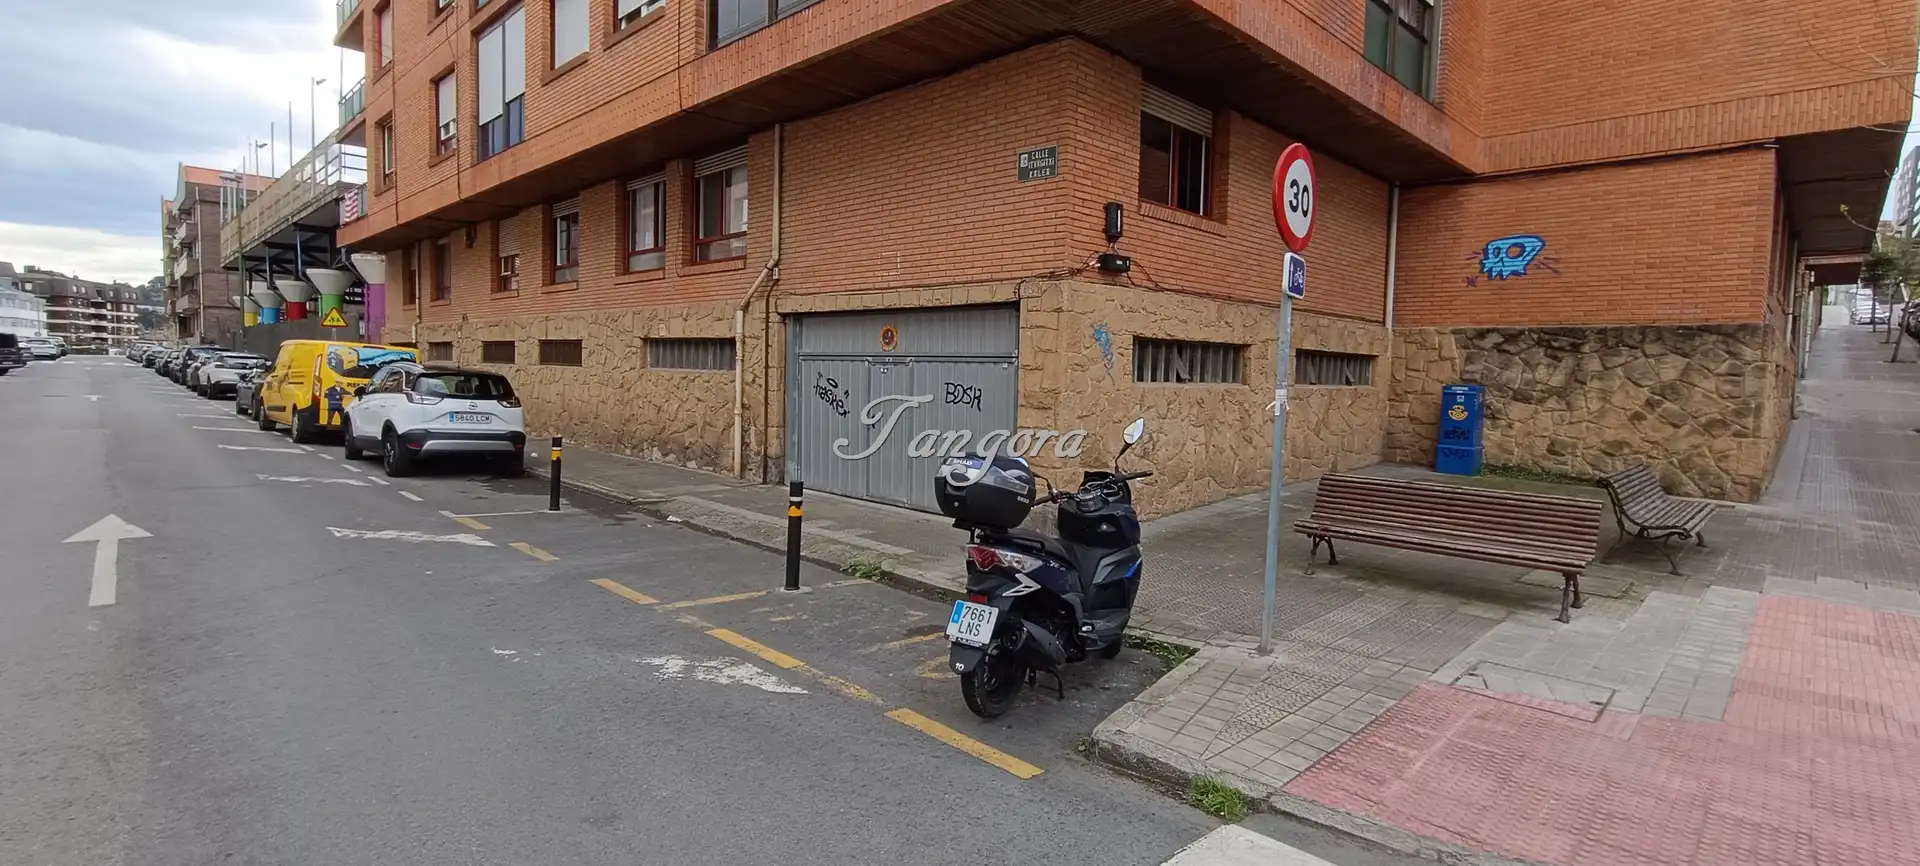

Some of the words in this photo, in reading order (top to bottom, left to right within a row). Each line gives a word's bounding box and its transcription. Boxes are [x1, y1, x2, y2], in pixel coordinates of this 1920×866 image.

[1031, 149, 1049, 159] CALLE
[1029, 168, 1050, 178] KALEA
[1288, 178, 1310, 218] 30
[962, 605, 993, 625] 7661
[957, 619, 982, 637] LNS
[954, 662, 965, 671] 10
